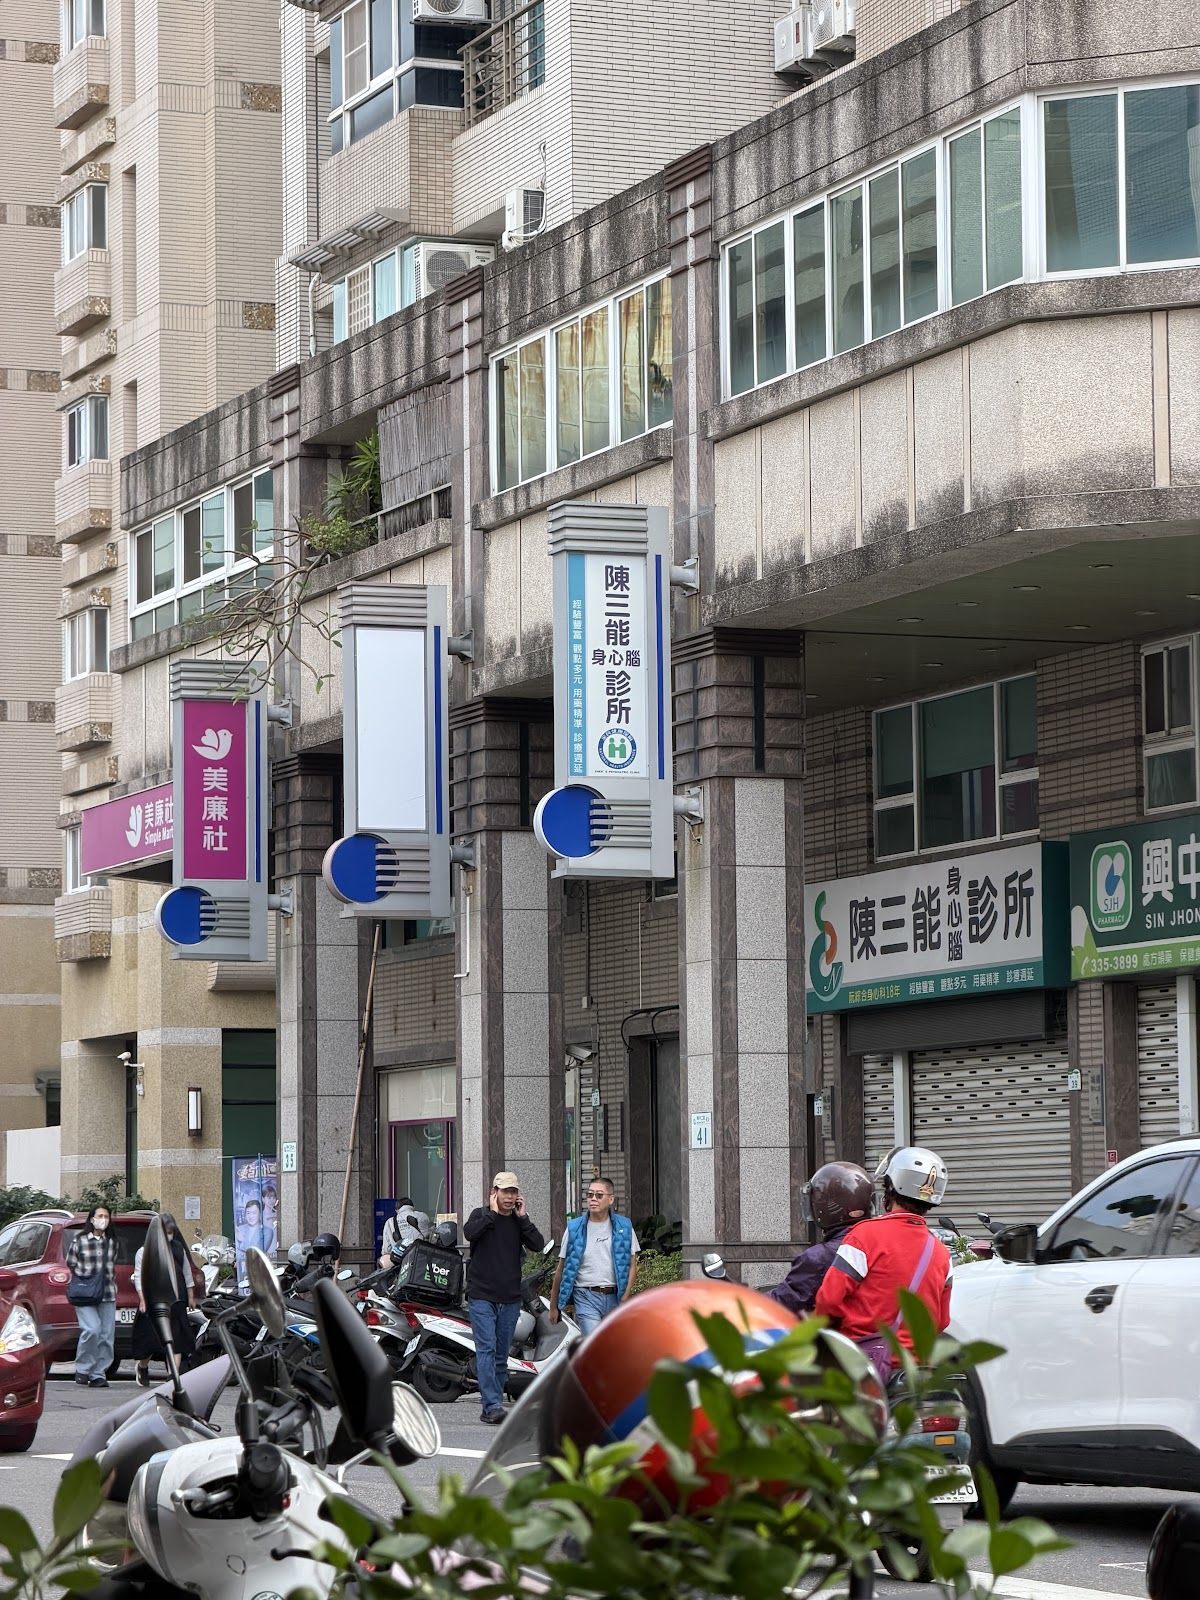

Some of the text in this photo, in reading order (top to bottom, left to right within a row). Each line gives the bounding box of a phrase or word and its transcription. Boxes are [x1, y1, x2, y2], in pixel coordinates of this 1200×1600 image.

[604, 565, 630, 646] 陳三能
[591, 648, 641, 667] 身心腦
[605, 670, 631, 724] 診所
[144, 796, 173, 830] 美廉社
[202, 767, 229, 851] 美廉社
[144, 829, 162, 847] Simple
[1141, 833, 1200, 906] 興中
[1103, 897, 1119, 912] SJH
[849, 866, 1035, 963] 陳三能 身心腦 診所
[1097, 914, 1125, 925] PHARMACY
[1145, 912, 1165, 929] SIN
[1090, 954, 1138, 973] 335-3899
[909, 979, 935, 996] 經驗豐富
[940, 976, 967, 992] 觀點多元
[972, 972, 1000, 988] 用藥精準
[697, 1127, 706, 1144] 41
[286, 1153, 293, 1168] 35
[120, 1310, 136, 1321] 816
